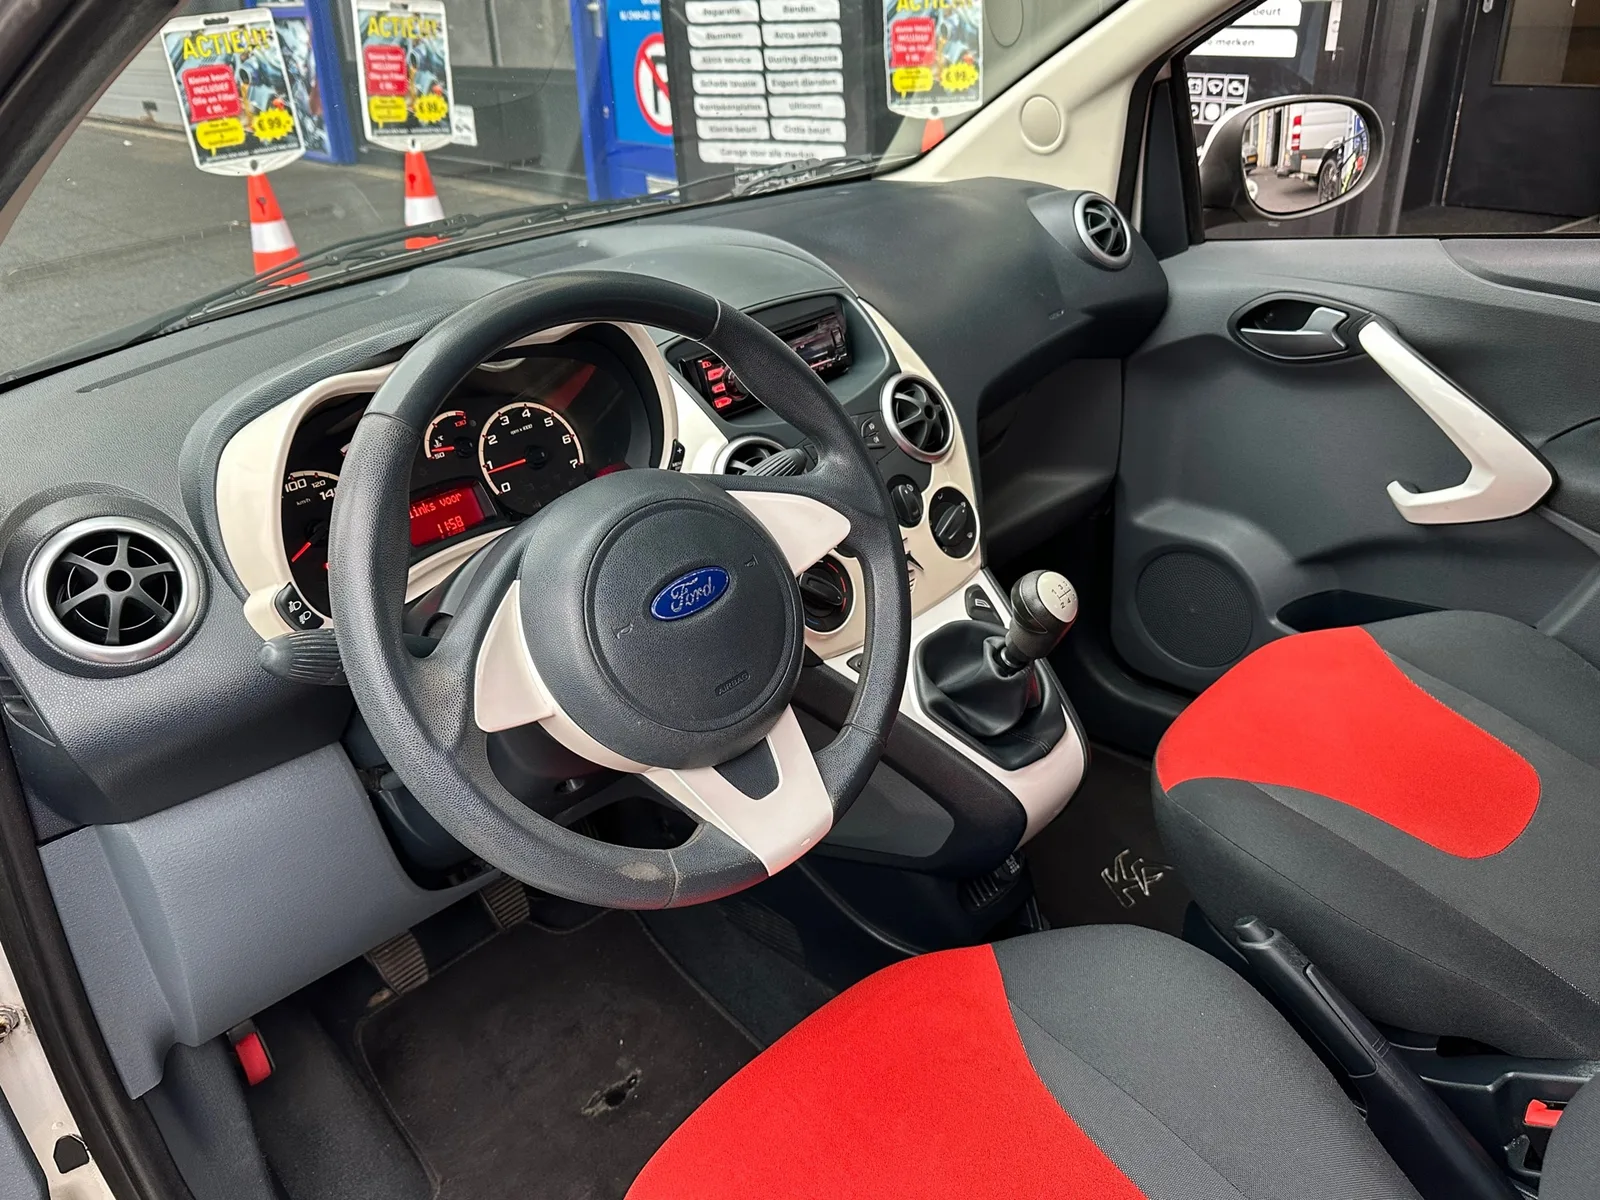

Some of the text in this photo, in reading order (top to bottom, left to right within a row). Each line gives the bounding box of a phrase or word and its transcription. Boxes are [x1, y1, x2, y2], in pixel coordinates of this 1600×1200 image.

[183, 27, 270, 60] ACTIE!!!
[1215, 37, 1255, 46] merken
[522, 409, 531, 418] 4
[500, 416, 510, 426] 3
[544, 417, 554, 427] 5
[488, 434, 498, 445] 2
[562, 434, 572, 444] 6
[487, 460, 493, 469] 1
[570, 459, 578, 469] 7
[285, 478, 307, 493] 100
[311, 480, 326, 489] 120
[501, 482, 511, 493] 0
[319, 488, 336, 501] 14
[439, 493, 462, 507] voor
[437, 516, 465, 534] 11:58
[670, 576, 717, 613] Ford
[717, 671, 750, 696] AIRBAG
